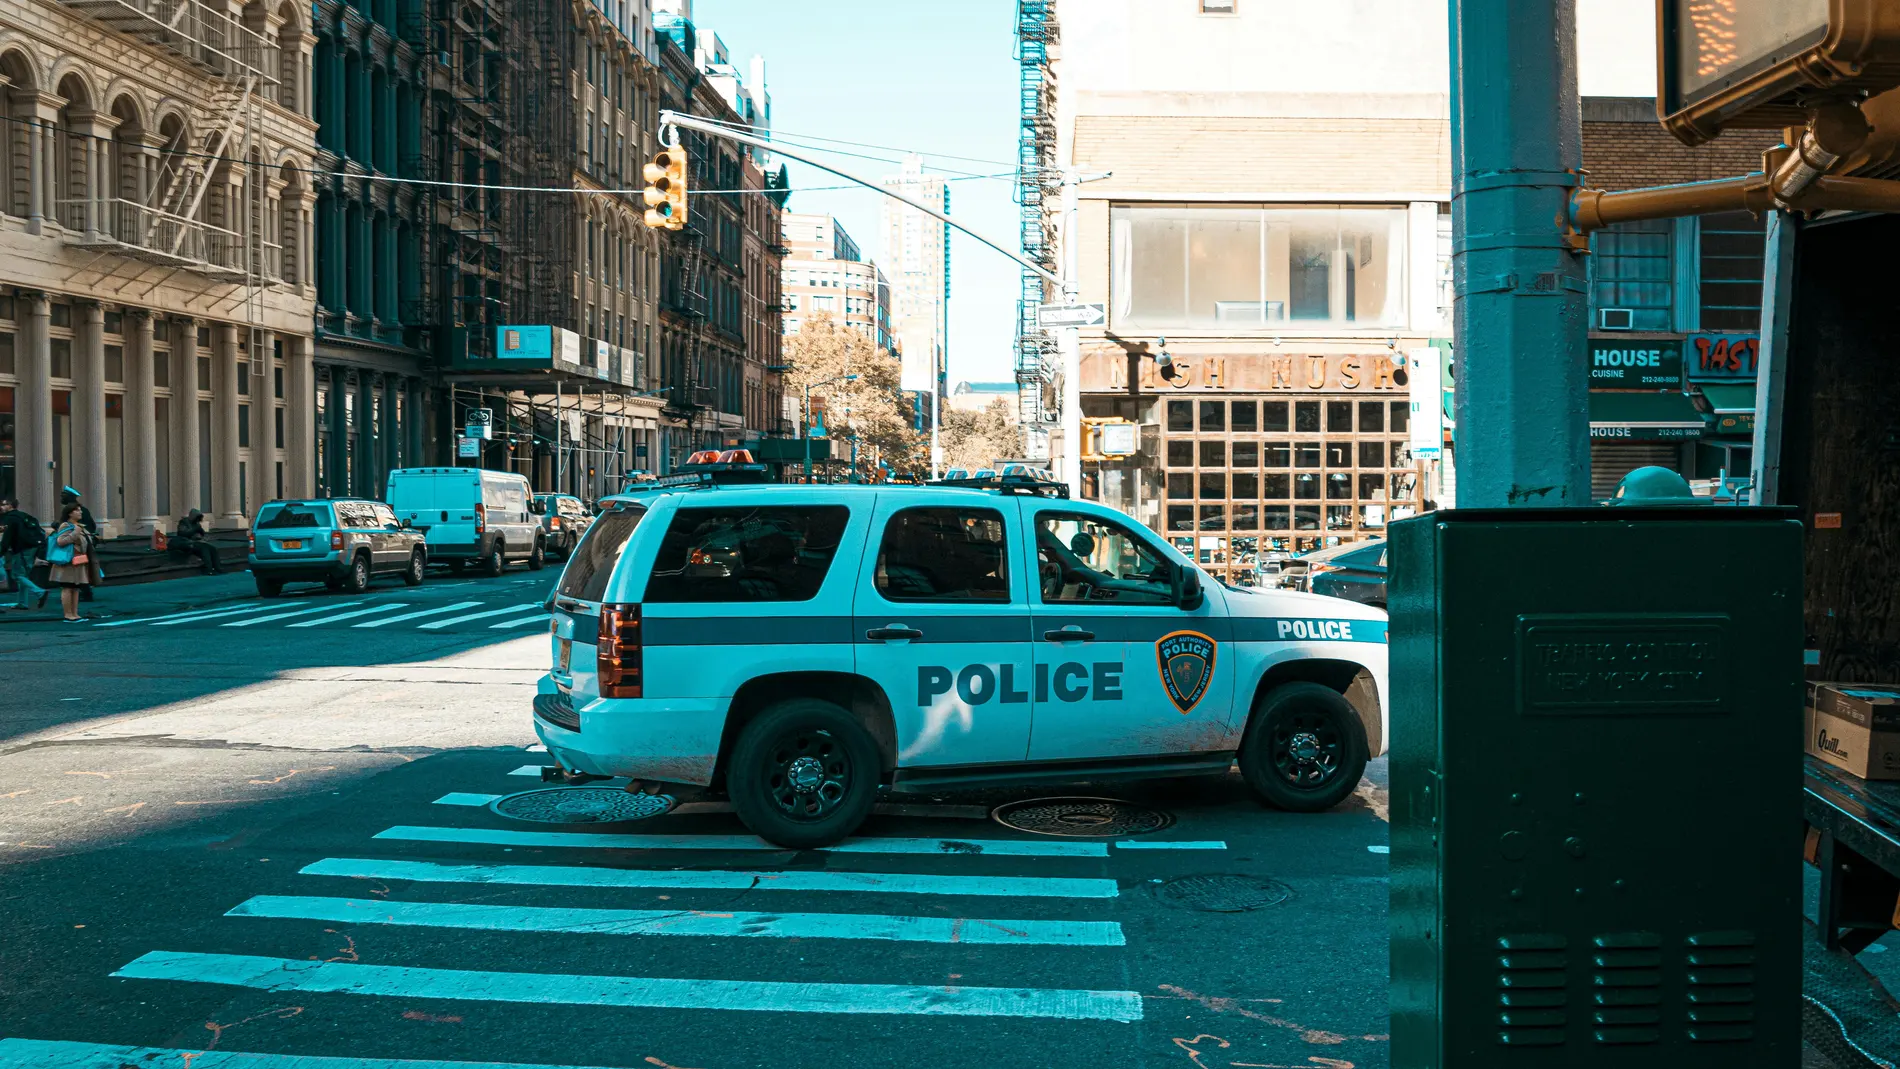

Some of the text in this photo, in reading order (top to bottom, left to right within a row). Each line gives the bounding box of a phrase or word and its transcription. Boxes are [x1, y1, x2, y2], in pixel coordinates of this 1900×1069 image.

[1594, 349, 1660, 367] HOUSE
[1110, 356, 1225, 389] NISH
[1592, 369, 1624, 378] CUISINE
[1590, 428, 1631, 437] HOUSE
[1276, 620, 1353, 640] POLICE
[1161, 636, 1212, 650] PORT AUTHORITY
[1163, 642, 1209, 658] POLICE
[917, 661, 1124, 707] POLICE
[1163, 668, 1180, 700] NEW YORK
[1191, 664, 1211, 702] NEW JERSEY
[1818, 729, 1848, 758] Quill.com
